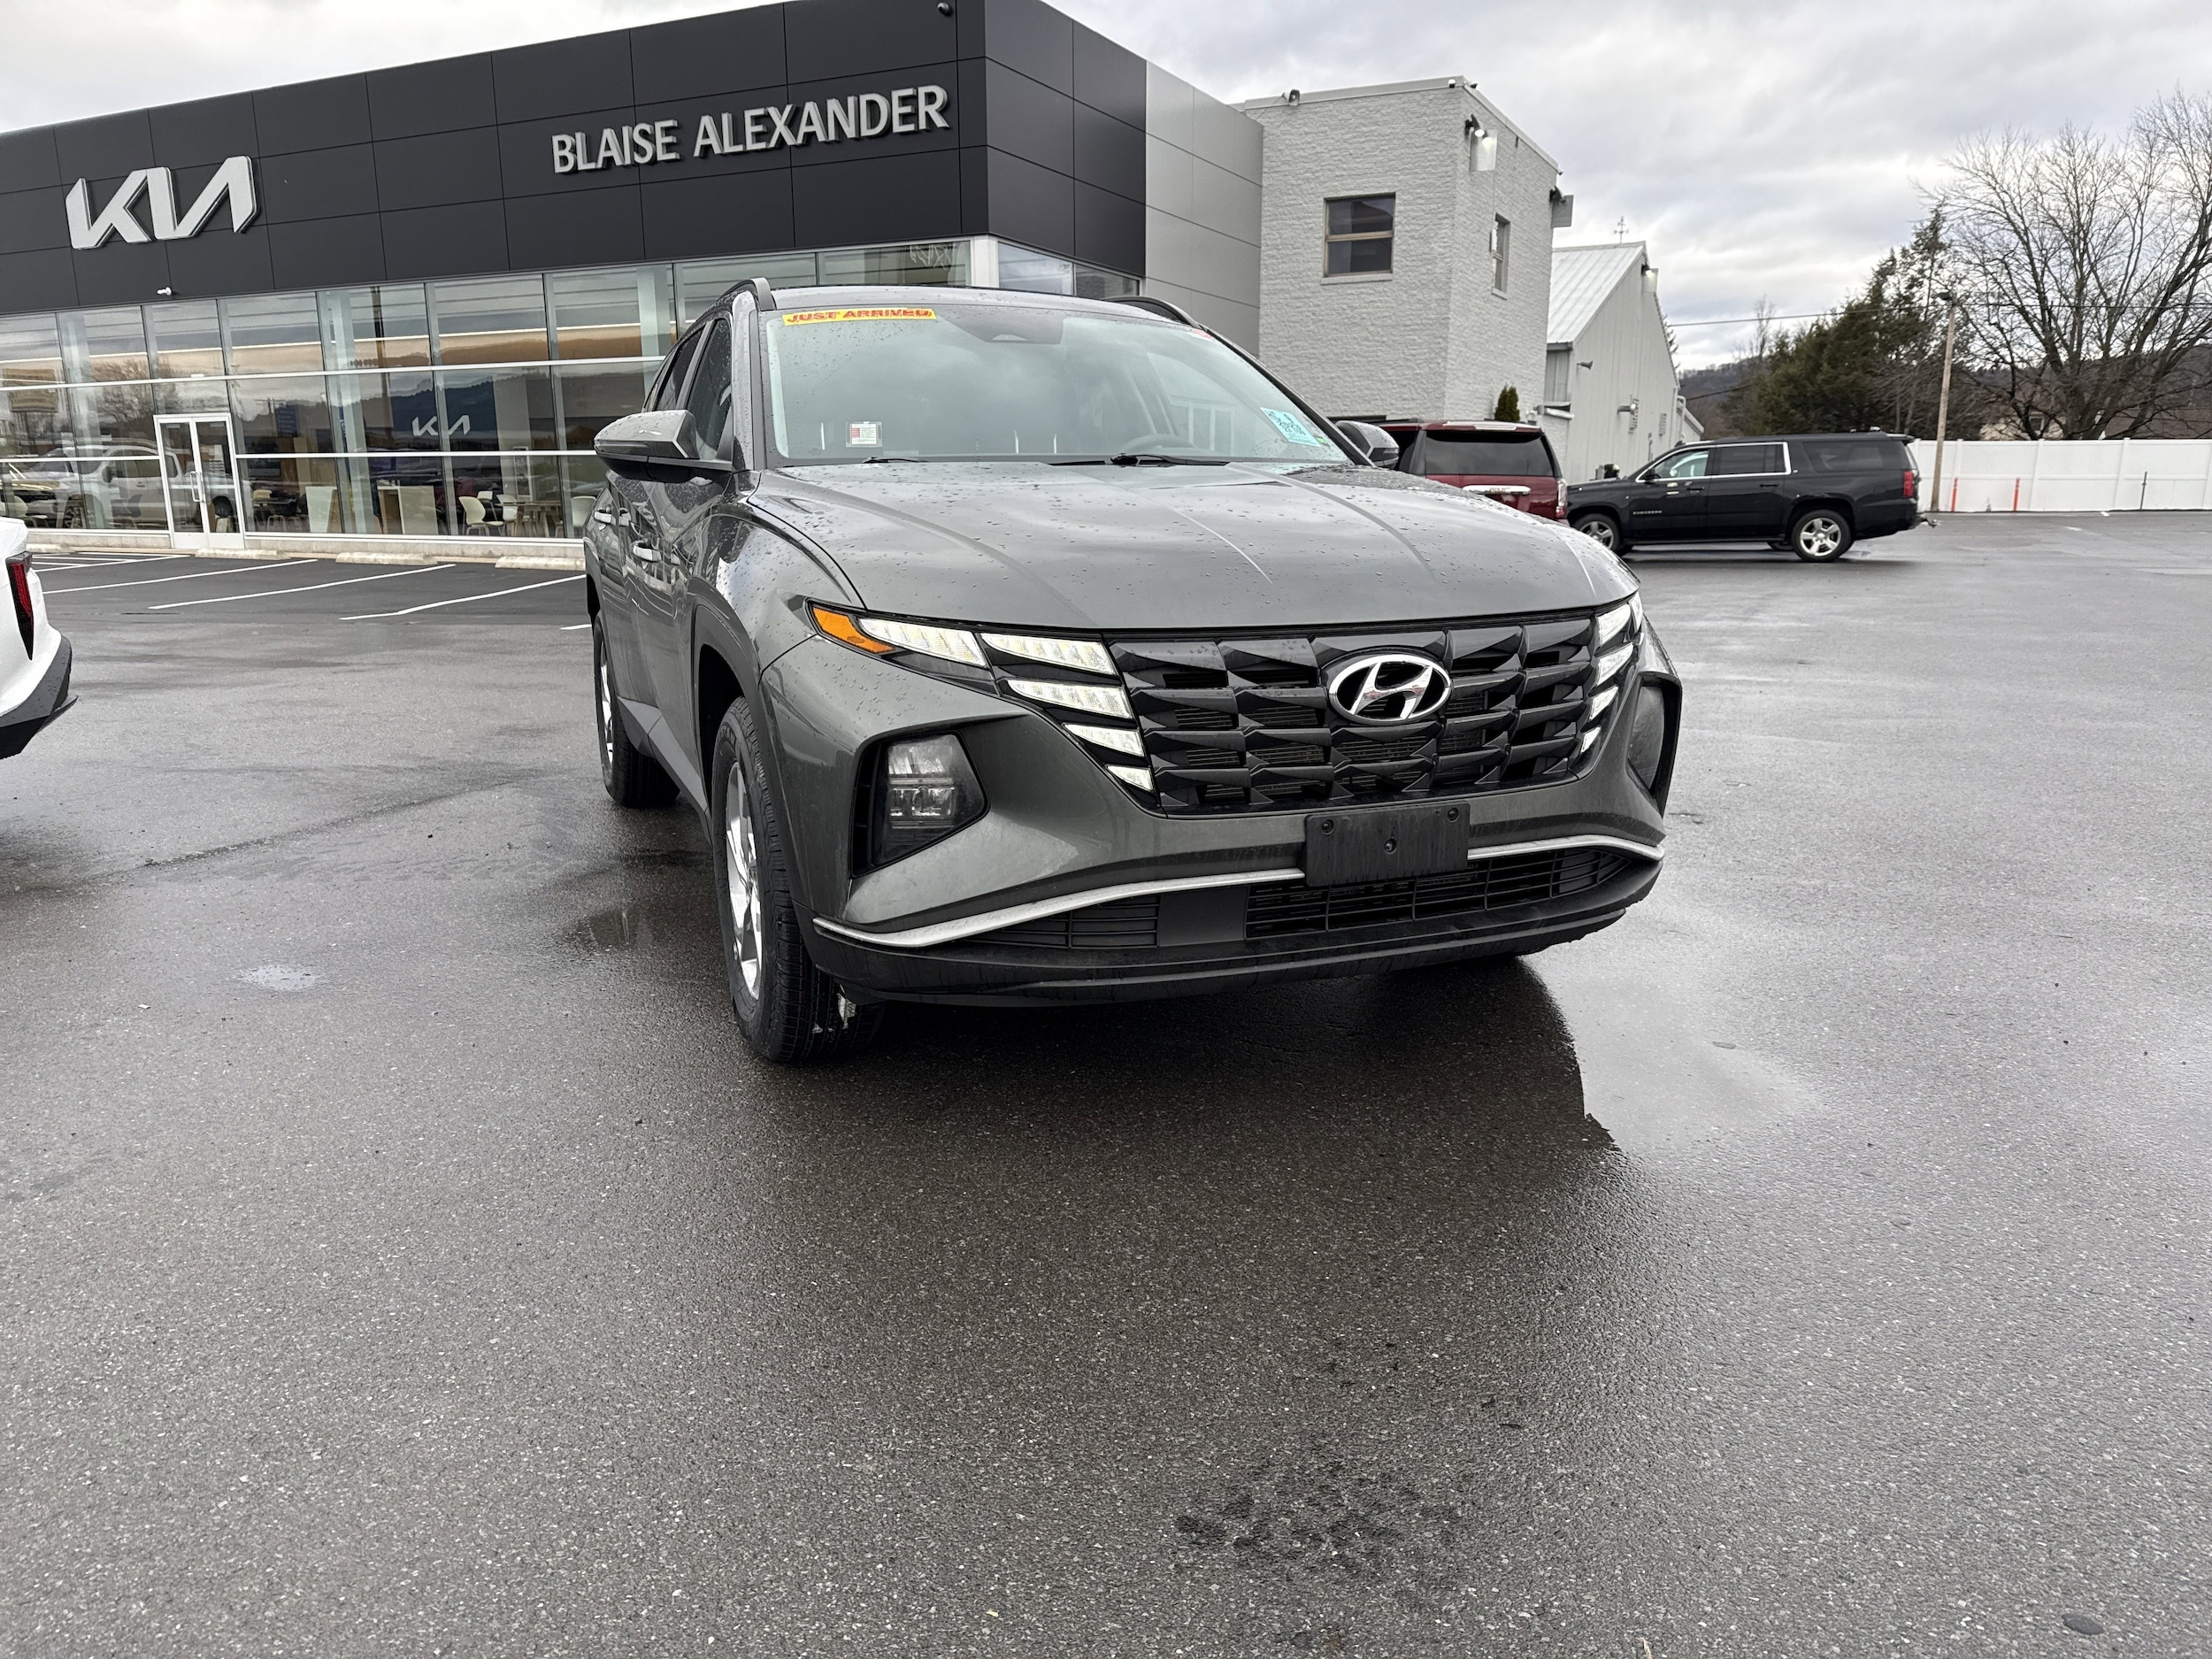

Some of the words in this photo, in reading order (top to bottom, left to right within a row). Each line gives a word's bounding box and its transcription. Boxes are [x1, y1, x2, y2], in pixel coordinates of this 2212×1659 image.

[552, 119, 680, 174] BLAISE
[693, 85, 950, 157] ALEXANDER
[65, 155, 257, 250] KIA
[787, 311, 838, 323] JUST
[843, 309, 932, 319] ARRIVED
